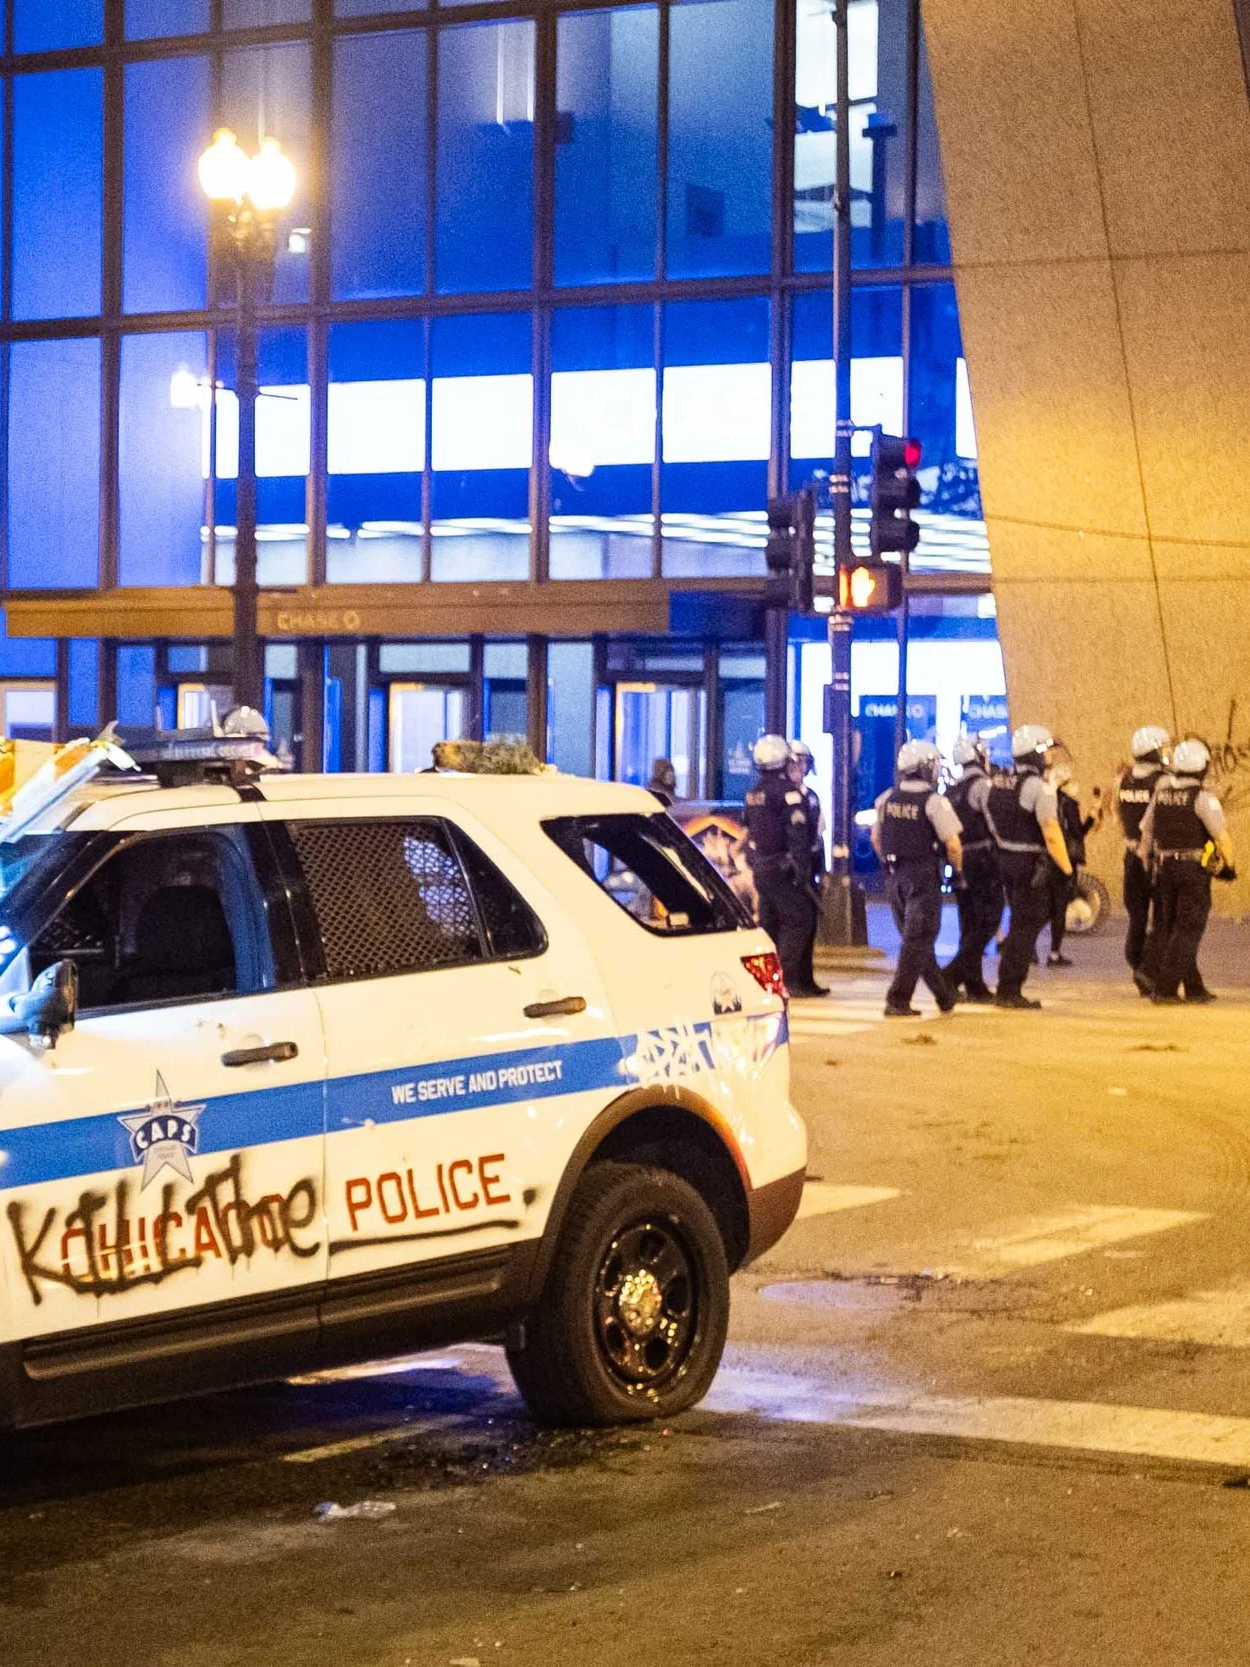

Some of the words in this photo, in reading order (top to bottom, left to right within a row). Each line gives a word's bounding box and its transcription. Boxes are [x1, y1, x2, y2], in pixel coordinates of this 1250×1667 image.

[968, 703, 1007, 719] CHAS
[391, 1083, 416, 1105] WE
[417, 1075, 466, 1102] SERVE
[468, 1072, 498, 1093] AND
[499, 1060, 563, 1089] PROTECT
[135, 1119, 192, 1149] CAPS
[346, 1154, 511, 1231] POLICE
